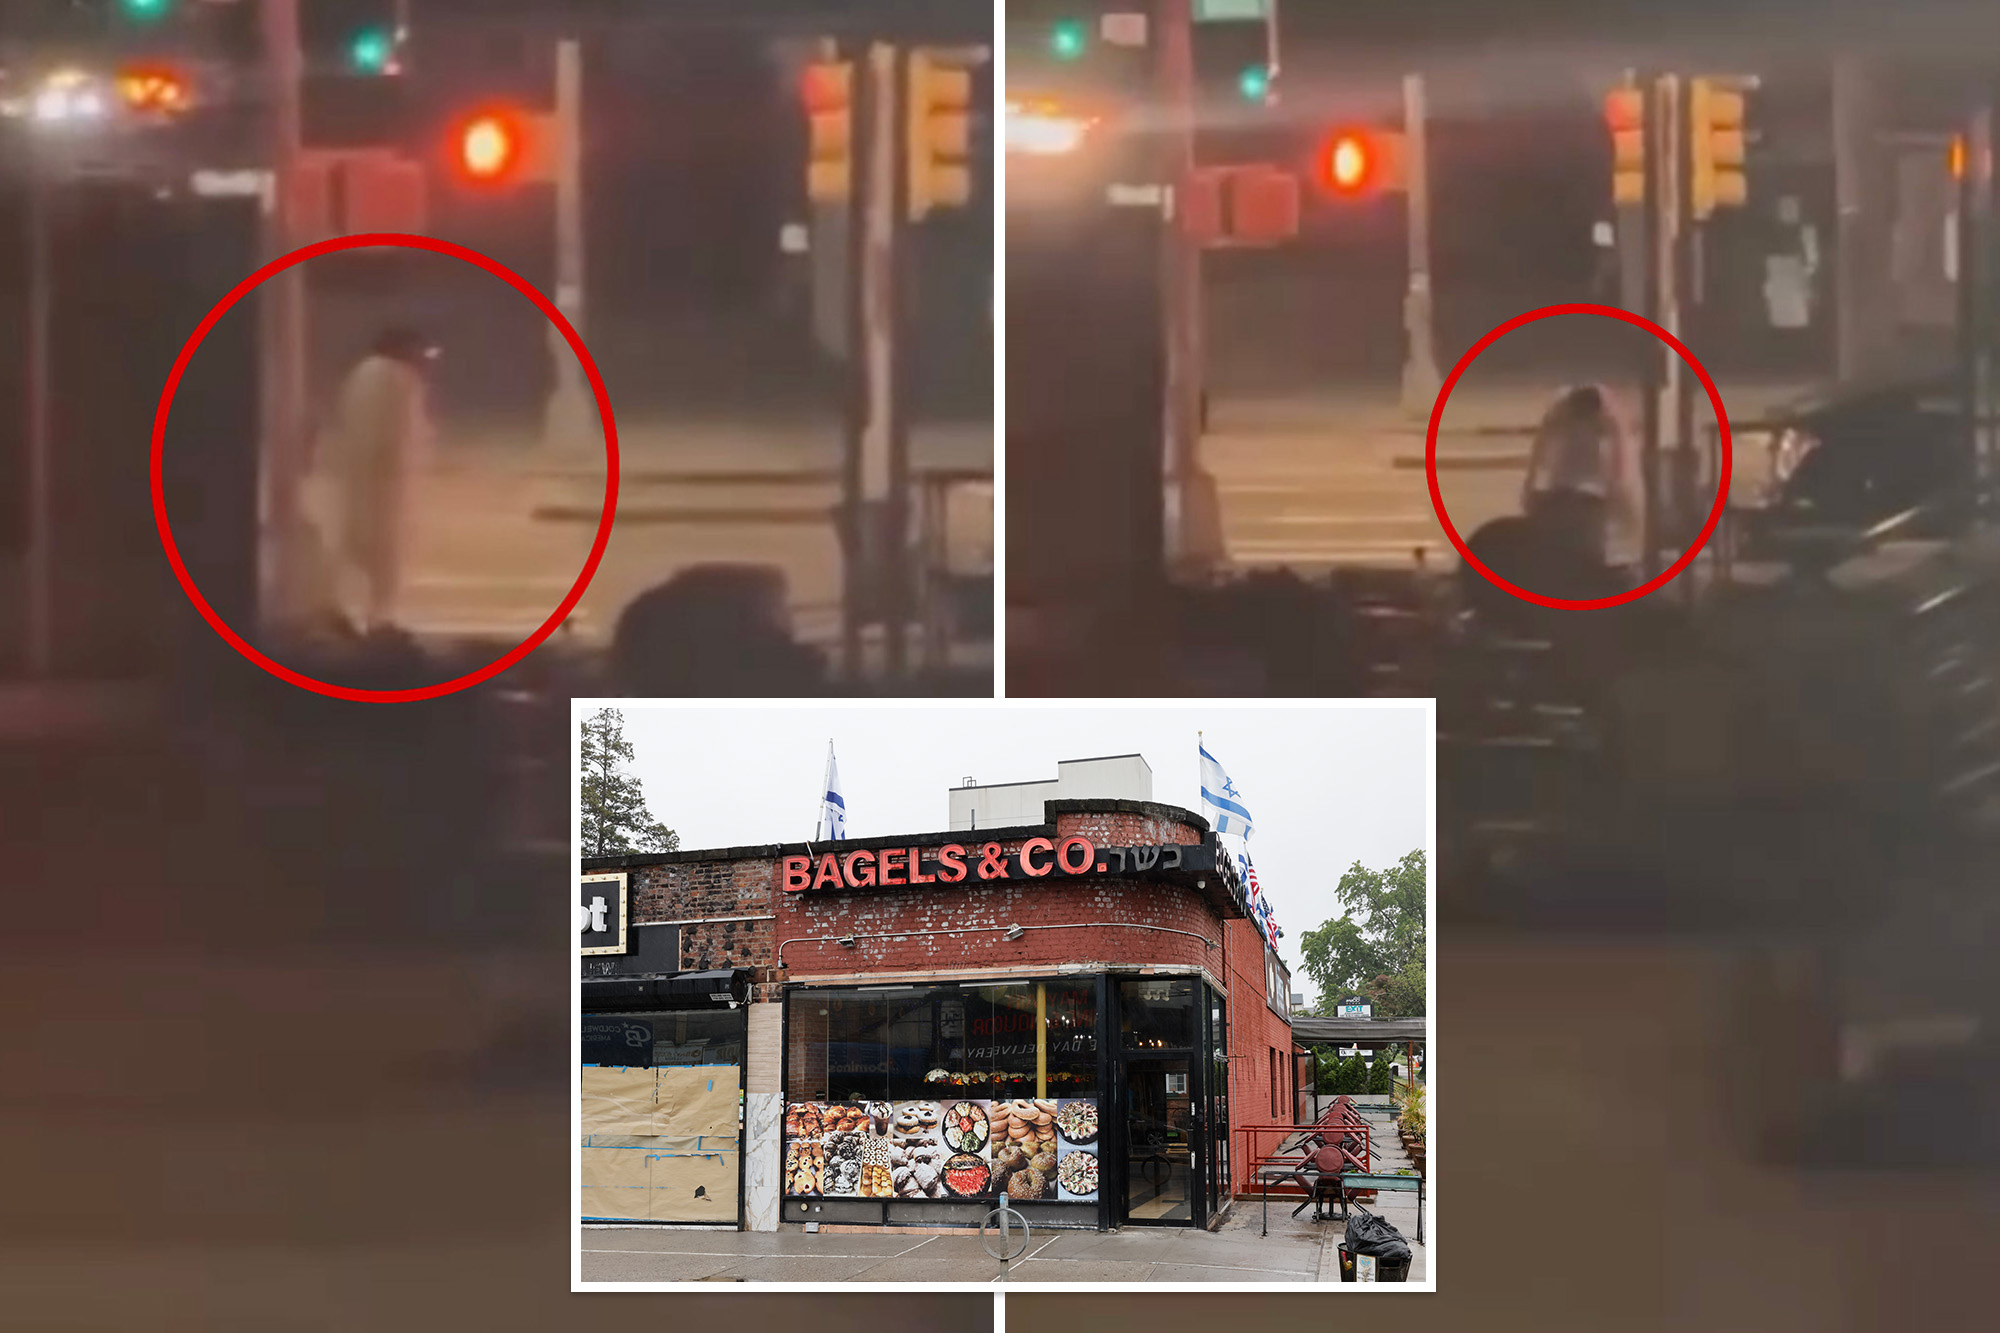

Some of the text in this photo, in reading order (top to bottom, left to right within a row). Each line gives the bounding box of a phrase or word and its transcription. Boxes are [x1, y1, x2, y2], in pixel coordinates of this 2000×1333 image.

[782, 835, 1107, 892] BAGELS & CO.
[1109, 843, 1183, 873] כשר
